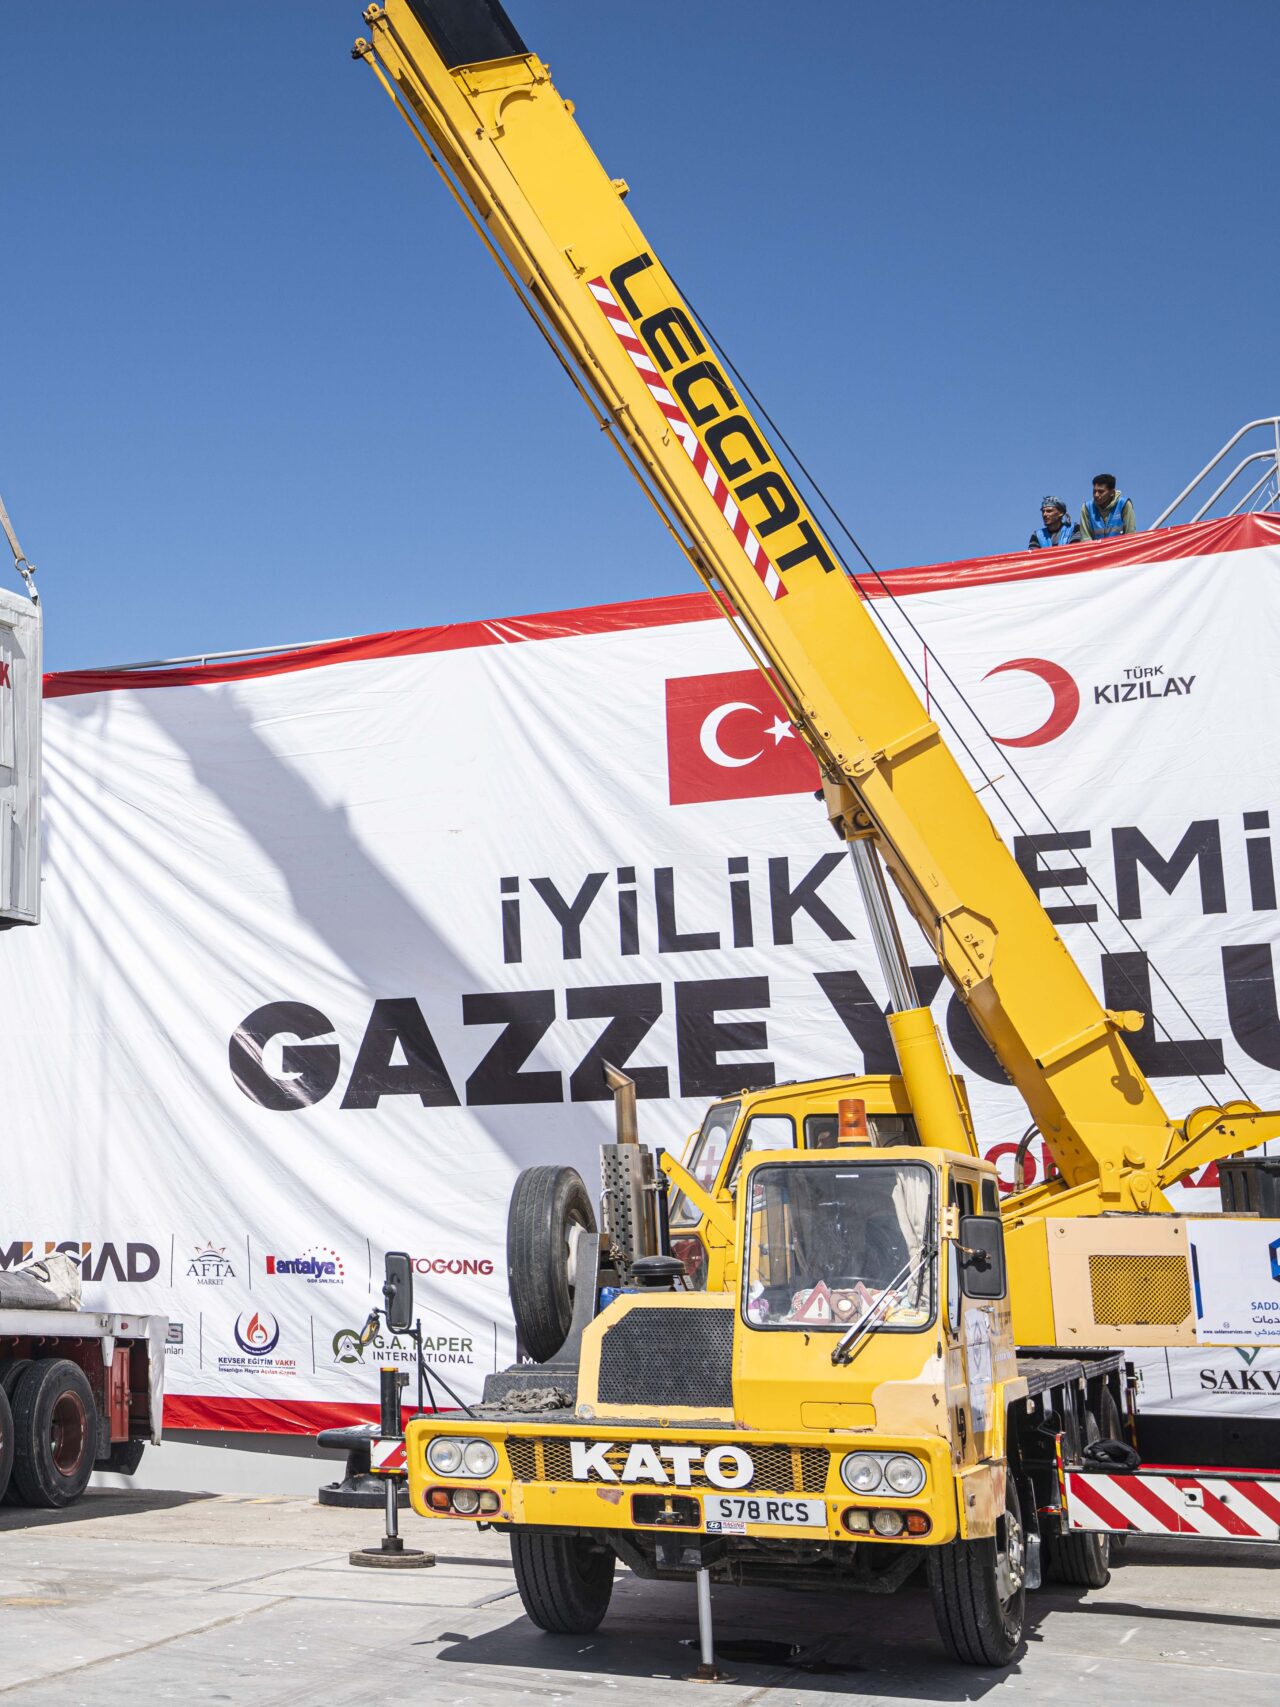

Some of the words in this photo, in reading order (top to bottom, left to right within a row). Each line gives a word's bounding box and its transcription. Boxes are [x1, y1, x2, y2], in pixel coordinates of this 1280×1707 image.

[609, 252, 836, 574] LEGGAT
[1123, 665, 1165, 680] TÜRK
[1093, 675, 1197, 705] KIZILAY
[499, 851, 857, 965] İYİLİK
[1013, 810, 1278, 926] EMİ
[228, 975, 777, 1112] GAZZE
[186, 1263, 237, 1278] AFTA
[276, 1256, 336, 1279] antalya
[409, 1258, 494, 1276] TOGONG
[197, 1278, 225, 1286] MARKET
[1250, 1301, 1280, 1311] SADD
[372, 1335, 407, 1350] G.A.
[218, 1357, 246, 1365] KEVSER
[247, 1357, 273, 1366] EĞİTİM
[274, 1359, 296, 1367] VAKFI
[372, 1351, 474, 1364] INTERNTIONAL
[570, 1441, 755, 1490] KATO
[719, 1498, 761, 1519] S78
[766, 1501, 810, 1522] RCS
